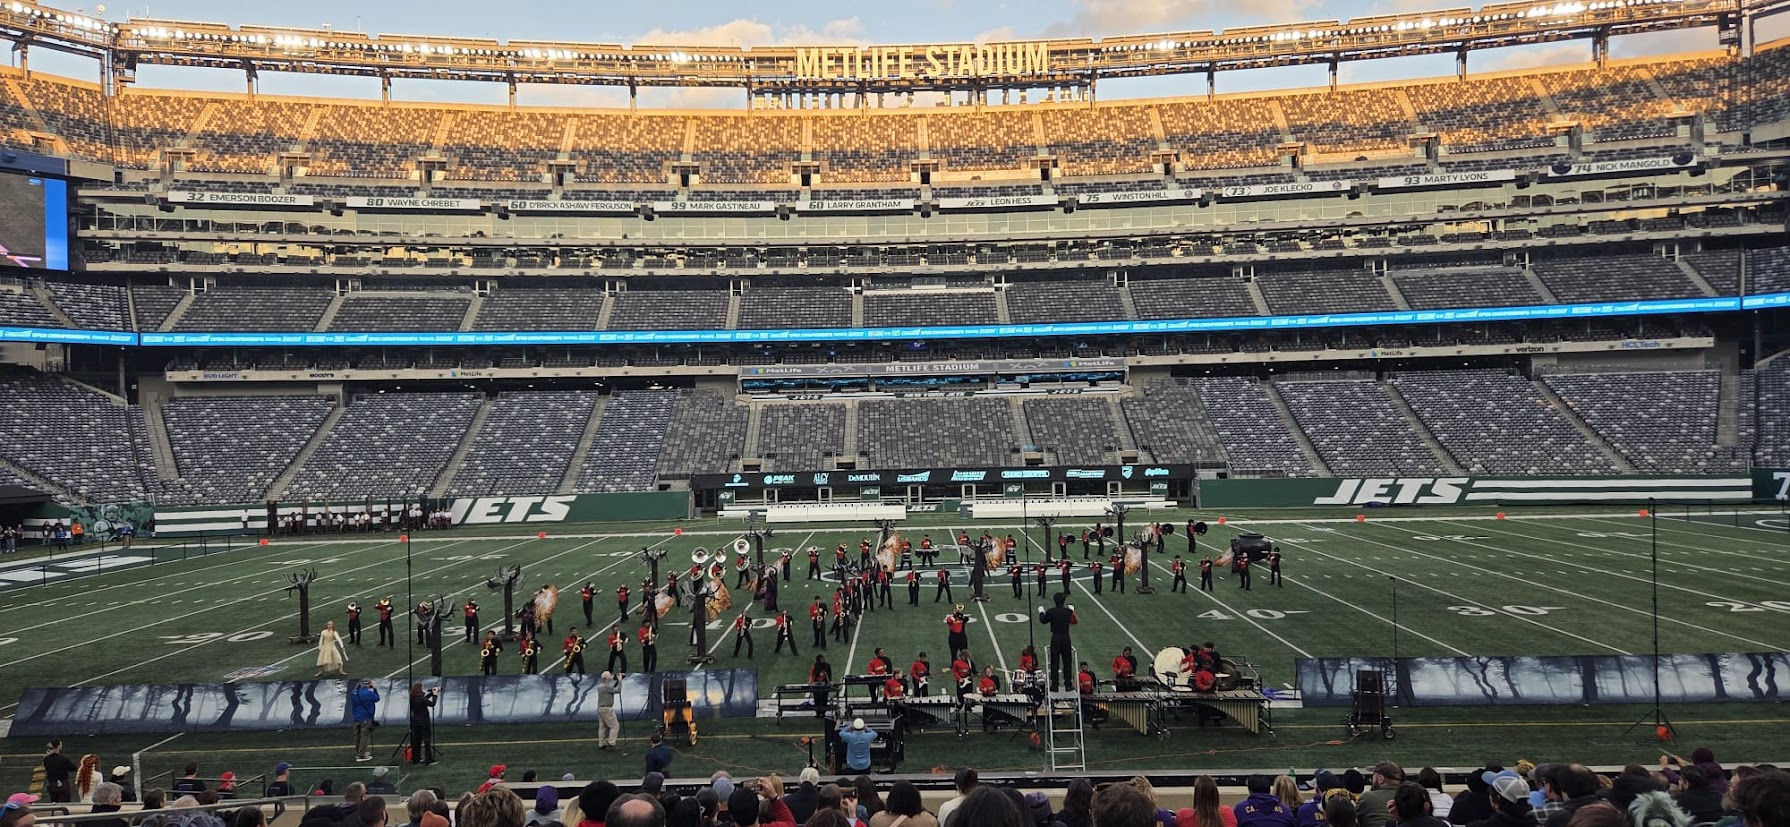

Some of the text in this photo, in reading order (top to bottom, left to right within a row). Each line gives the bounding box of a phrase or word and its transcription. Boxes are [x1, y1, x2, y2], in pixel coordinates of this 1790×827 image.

[797, 42, 1048, 79] METLIFE STADIUM
[1574, 160, 1670, 173] 74 NICK MANGOLD
[1404, 172, 1488, 186] 93 MARTY LYONS
[1230, 184, 1313, 196] 73 JOE KLECKO
[186, 192, 296, 204] 32 EMERSON BOOZER
[366, 198, 384, 206] 80
[387, 199, 420, 207] WAYNE
[1086, 194, 1100, 202] 75
[1112, 192, 1149, 200] WINSTON
[809, 202, 824, 210] 60
[1621, 340, 1660, 348] HCLTech
[1313, 478, 1470, 504] JETS
[450, 495, 577, 524] JETS
[1197, 609, 1287, 620] 40
[1447, 605, 1548, 616] 30
